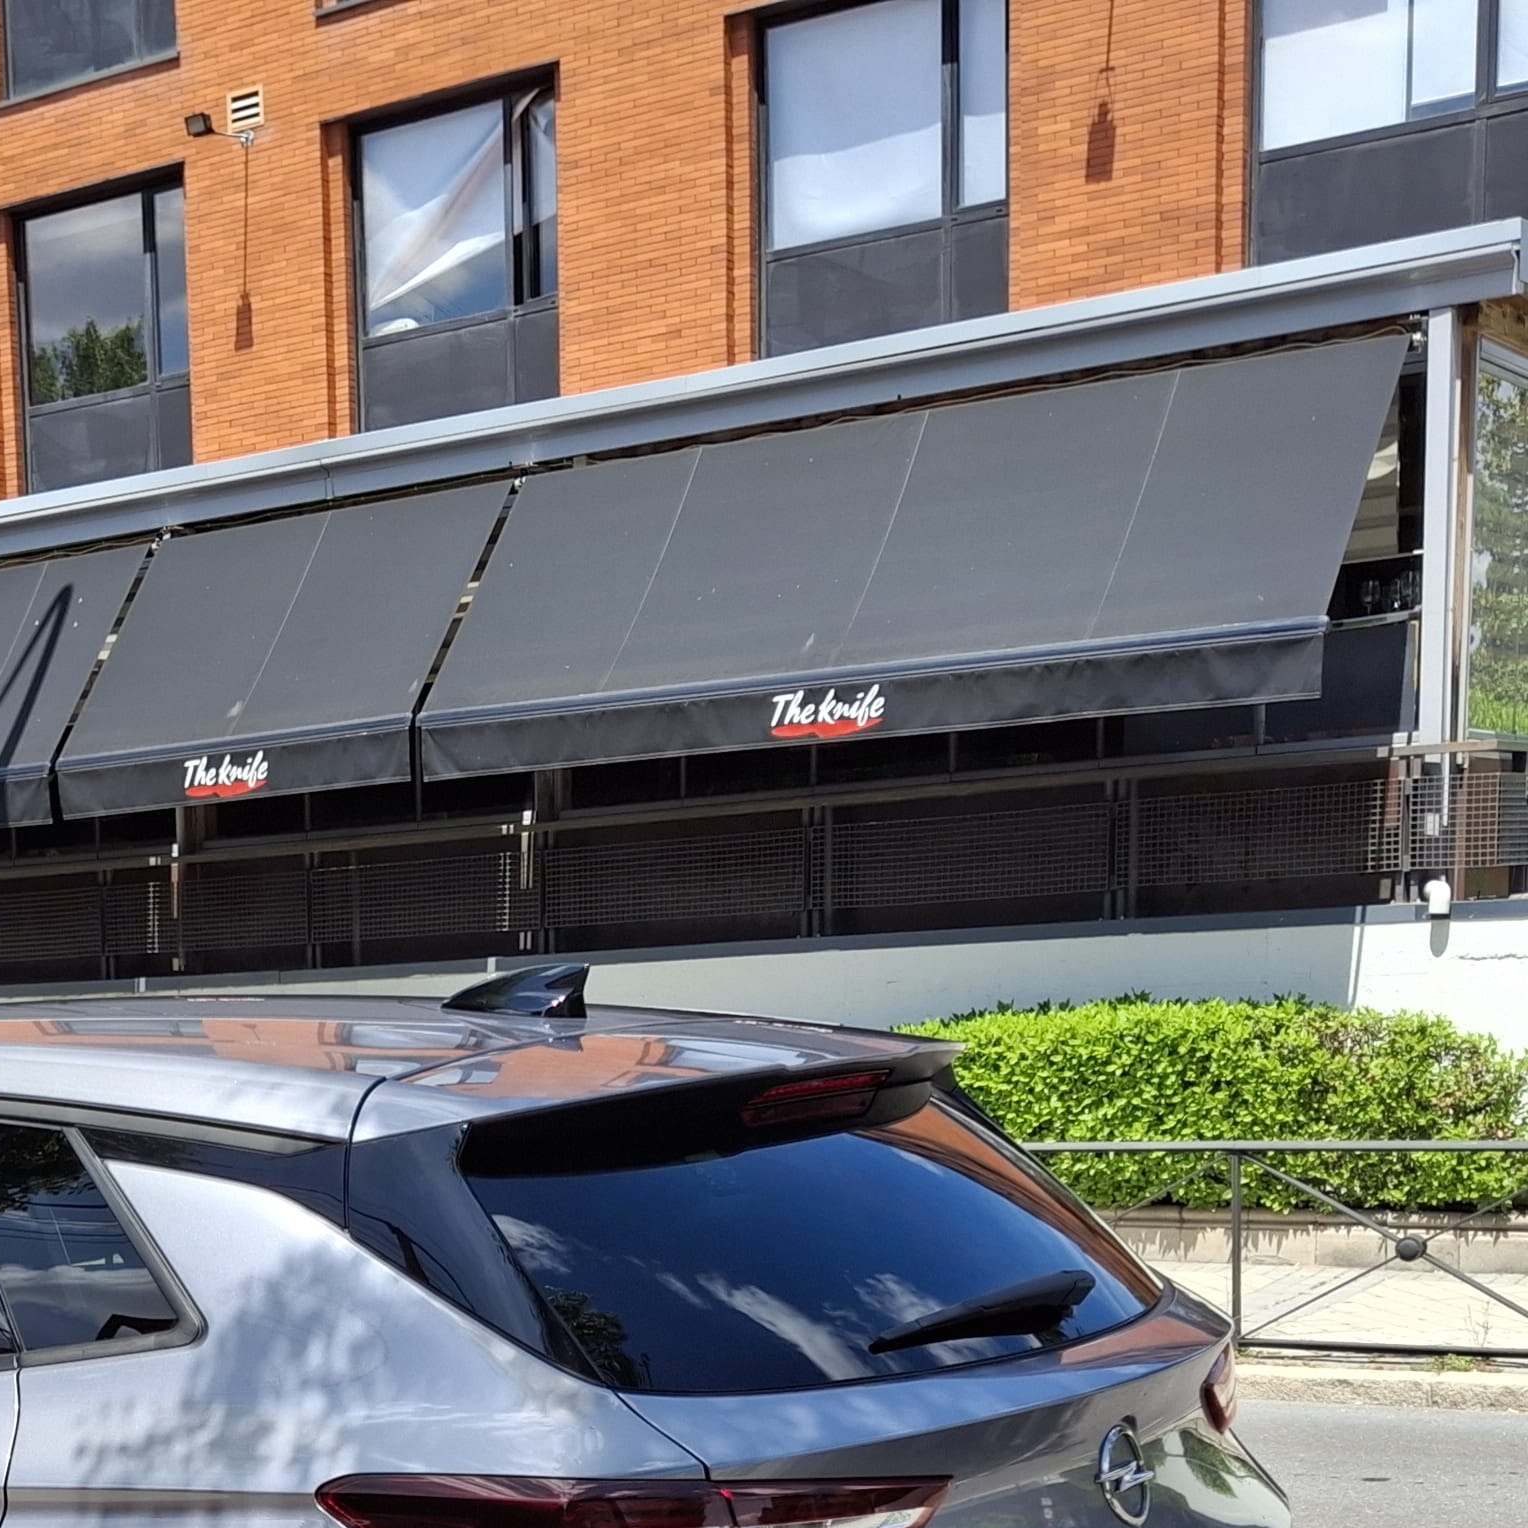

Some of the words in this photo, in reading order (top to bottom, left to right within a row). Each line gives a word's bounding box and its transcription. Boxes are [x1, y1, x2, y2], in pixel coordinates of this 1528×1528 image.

[770, 690, 816, 727] The
[817, 683, 886, 727] knife
[183, 755, 217, 789] The
[218, 749, 269, 788] knife
